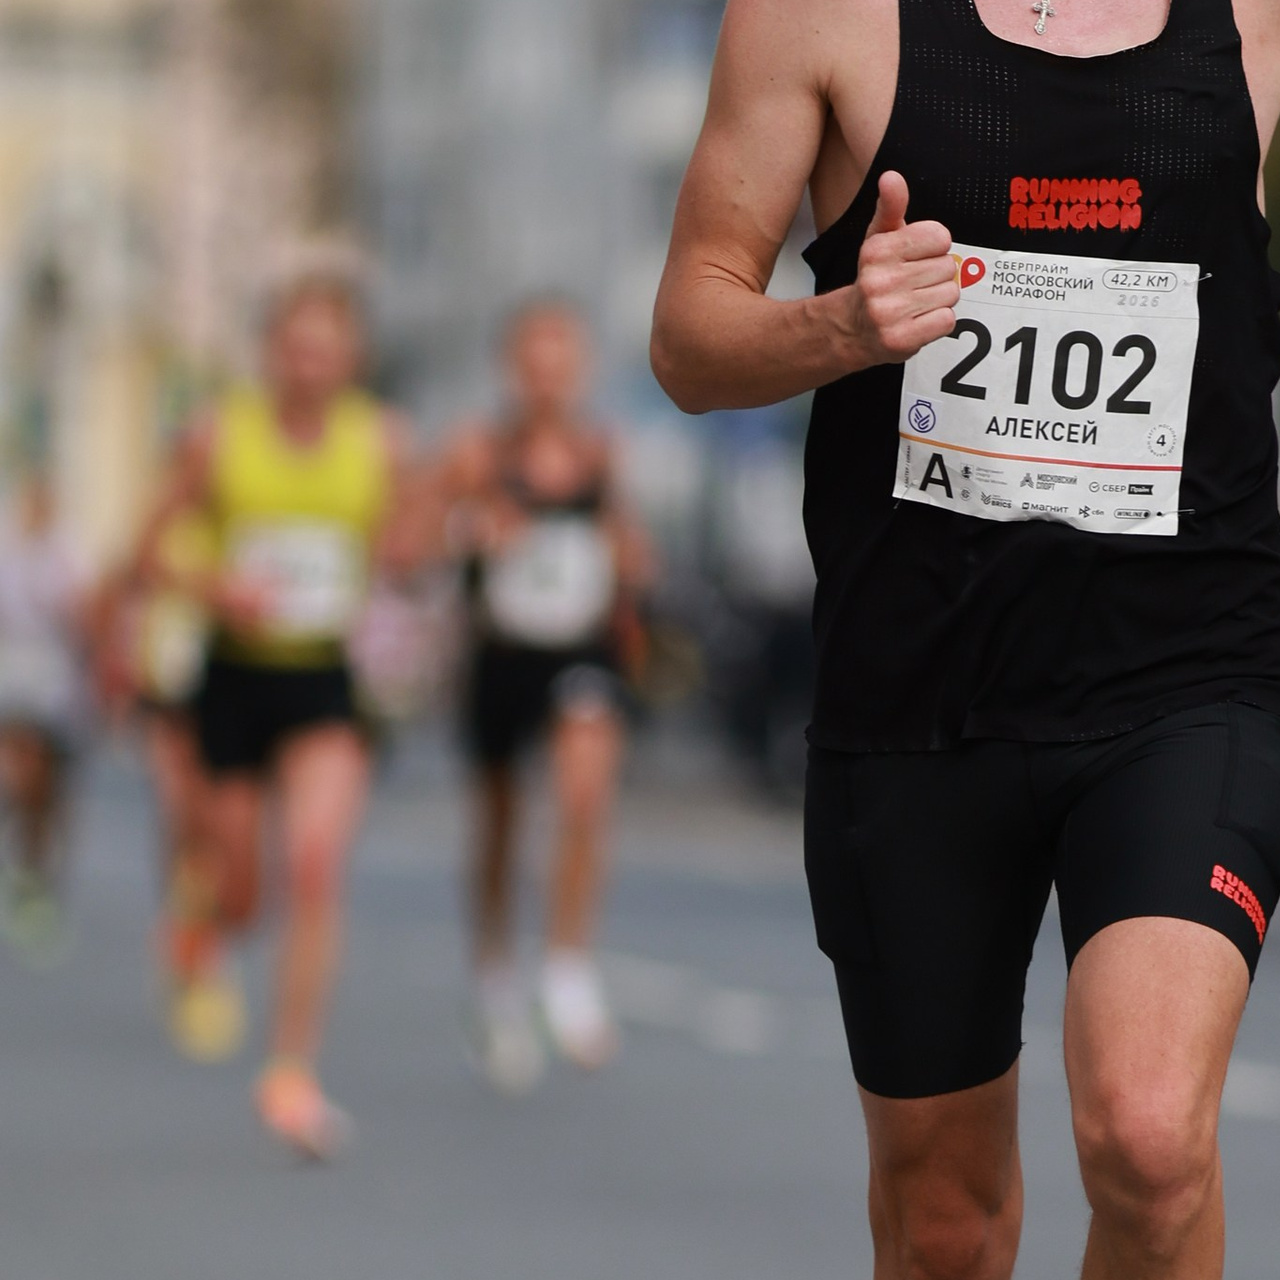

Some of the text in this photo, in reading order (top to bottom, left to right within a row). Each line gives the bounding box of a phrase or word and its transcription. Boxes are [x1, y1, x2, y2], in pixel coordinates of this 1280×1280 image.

[1009, 176, 1142, 203] RUNNING
[1009, 203, 1142, 232] RELIGION
[994, 260, 1069, 274] СБЕРПРАЙМ
[993, 271, 1094, 290] МОСКОВСКИЙ
[1111, 273, 1168, 287] 42,2 КМ
[991, 284, 1066, 301] МАРАФОН
[939, 318, 1157, 415] 2102
[985, 416, 1098, 445] АЛЕКСЕЙ
[1156, 434, 1166, 447] 4
[1036, 473, 1077, 485] МОСКОВСКИЙ
[1036, 482, 1055, 491] СПОРТ
[1102, 484, 1127, 493] СБЕР
[991, 500, 1012, 509] BRICS
